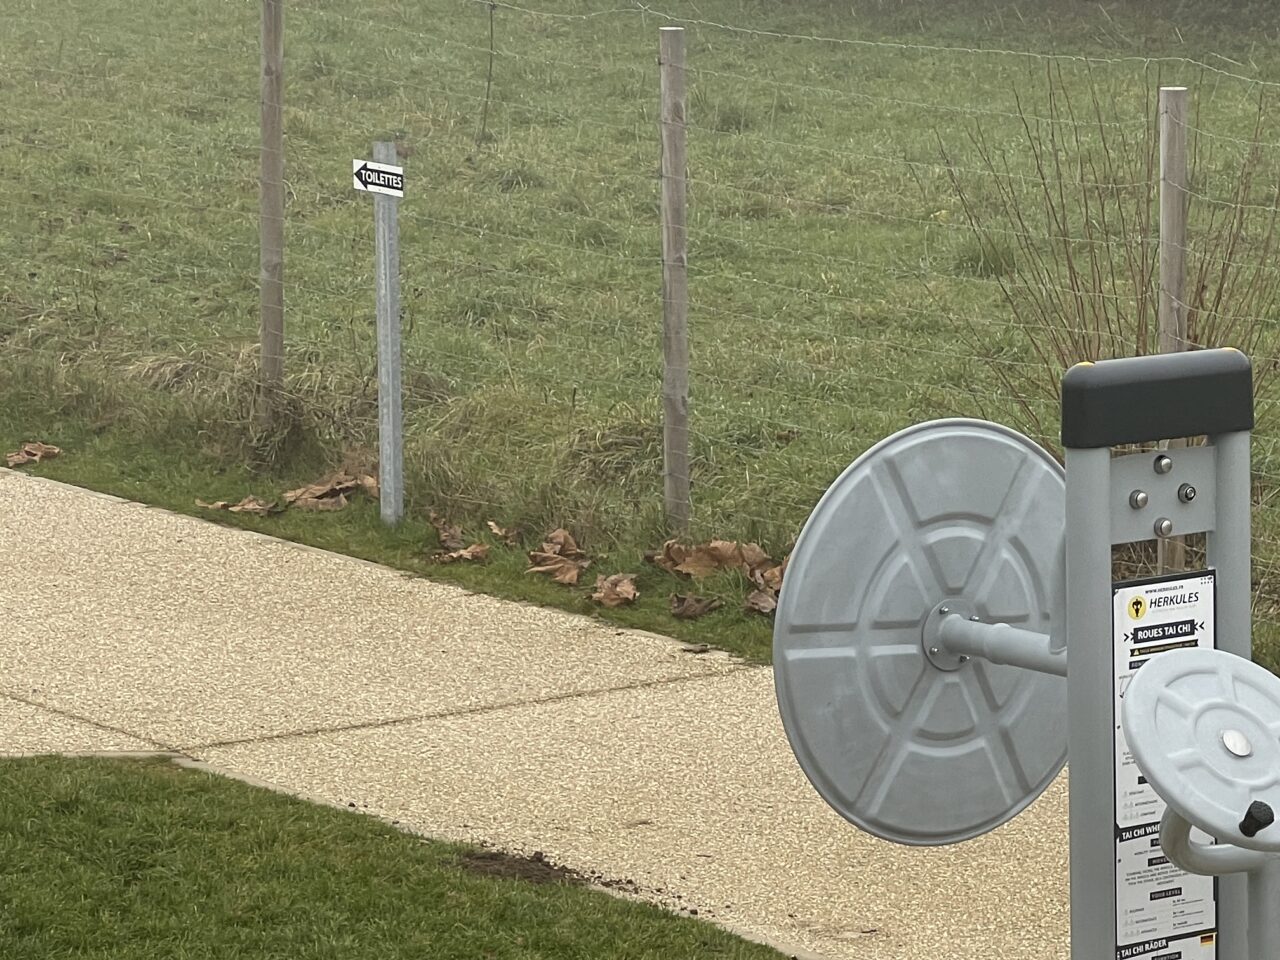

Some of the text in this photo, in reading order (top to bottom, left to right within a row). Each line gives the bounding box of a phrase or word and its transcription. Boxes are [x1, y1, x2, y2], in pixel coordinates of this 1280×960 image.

[360, 170, 402, 188] TOILETTES
[1149, 592, 1199, 608] HERKULES
[1137, 623, 1190, 640] ROUES TAI CHI
[1122, 830, 1133, 840] TAI
[1133, 828, 1145, 837] CHI
[1121, 939, 1167, 957] TAI CHI RÄDER
